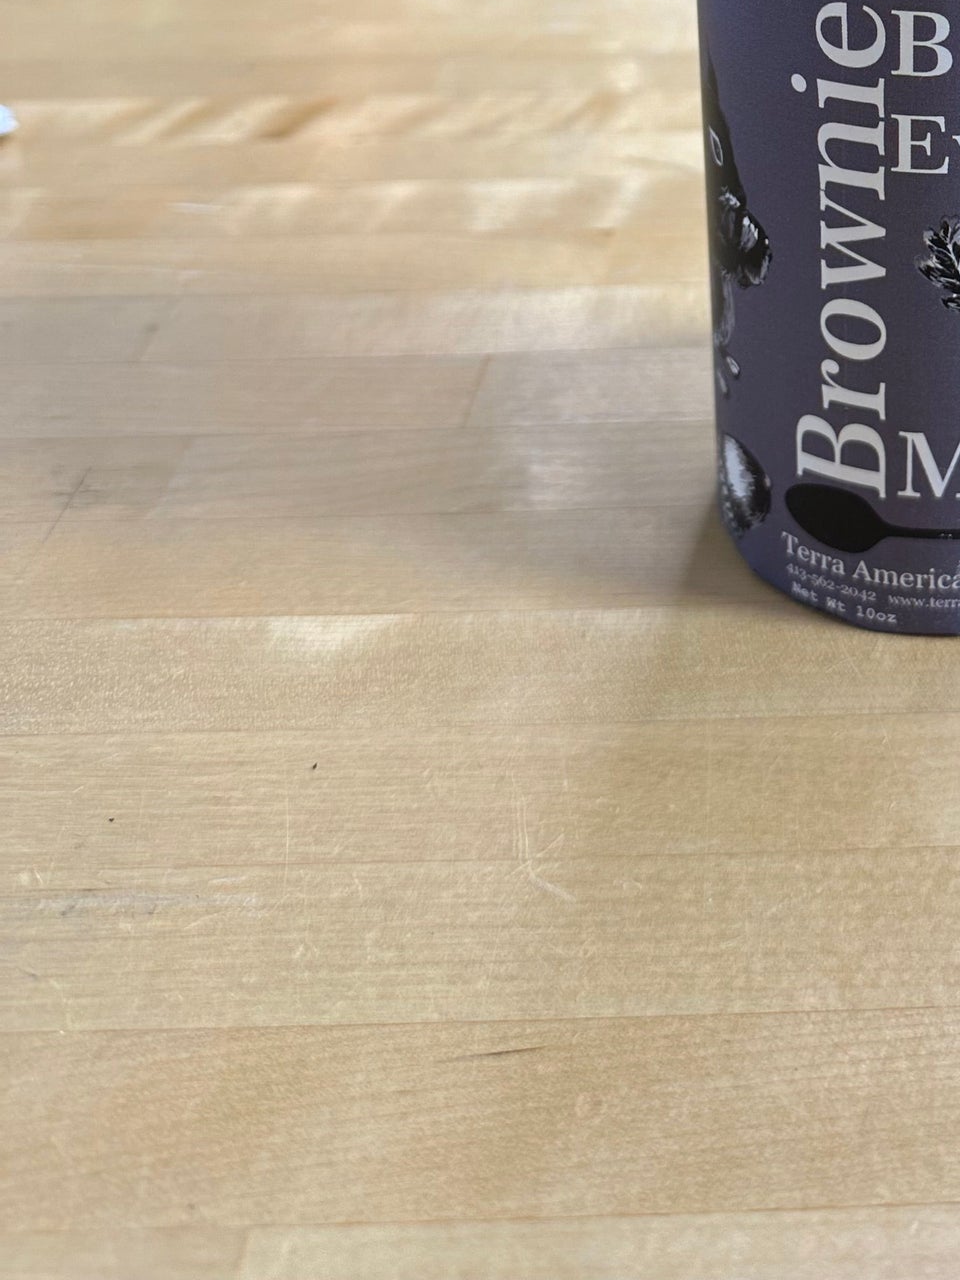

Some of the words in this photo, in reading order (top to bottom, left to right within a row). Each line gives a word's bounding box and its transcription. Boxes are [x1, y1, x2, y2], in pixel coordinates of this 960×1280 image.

[791, 1, 888, 500] Brownie
[781, 531, 845, 575] Terra
[786, 562, 877, 602] 413-562-2042
[791, 581, 818, 602] Net
[826, 596, 846, 612] Wt
[856, 604, 897, 623] 10oz
